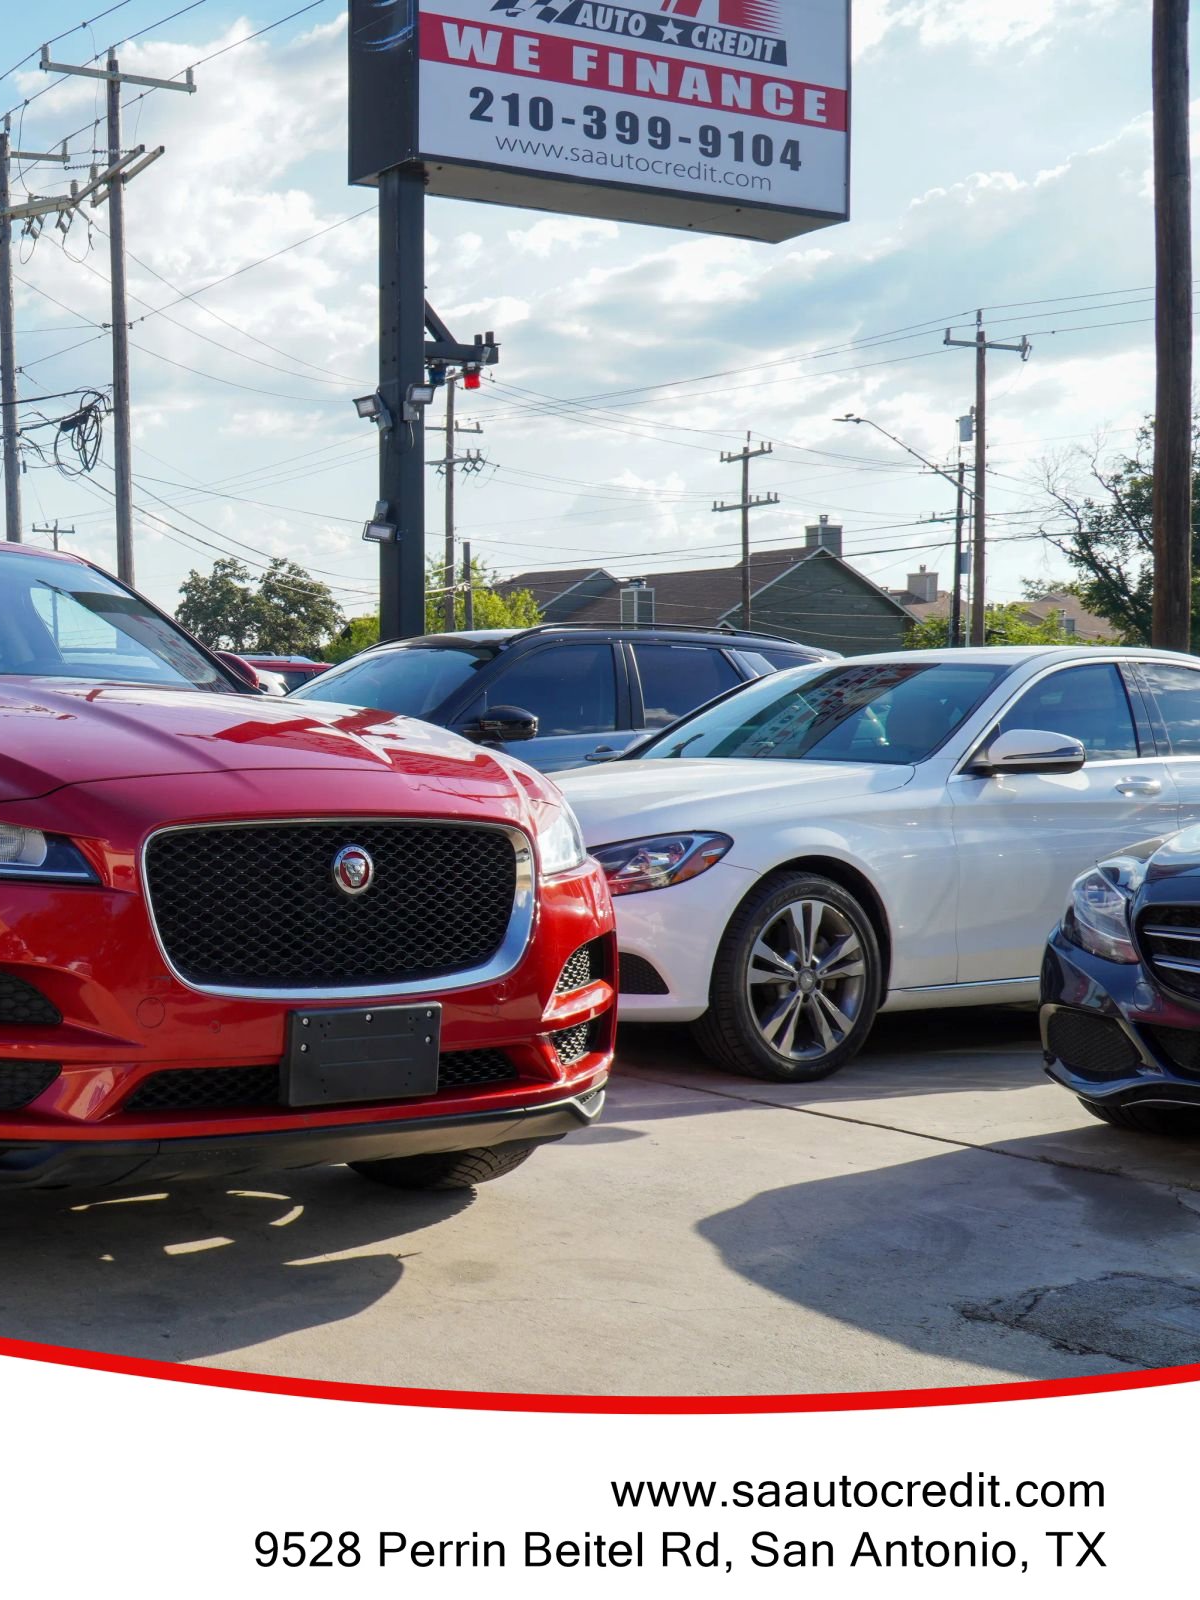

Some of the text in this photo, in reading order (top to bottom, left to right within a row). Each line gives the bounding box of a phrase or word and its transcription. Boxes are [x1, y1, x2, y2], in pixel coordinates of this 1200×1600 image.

[575, 3, 647, 38] AUTO
[690, 26, 779, 62] CREDIT
[441, 22, 828, 124] WE FINANCE
[469, 86, 803, 172] 210-399-9104
[495, 135, 772, 192] www.saautocredit.com
